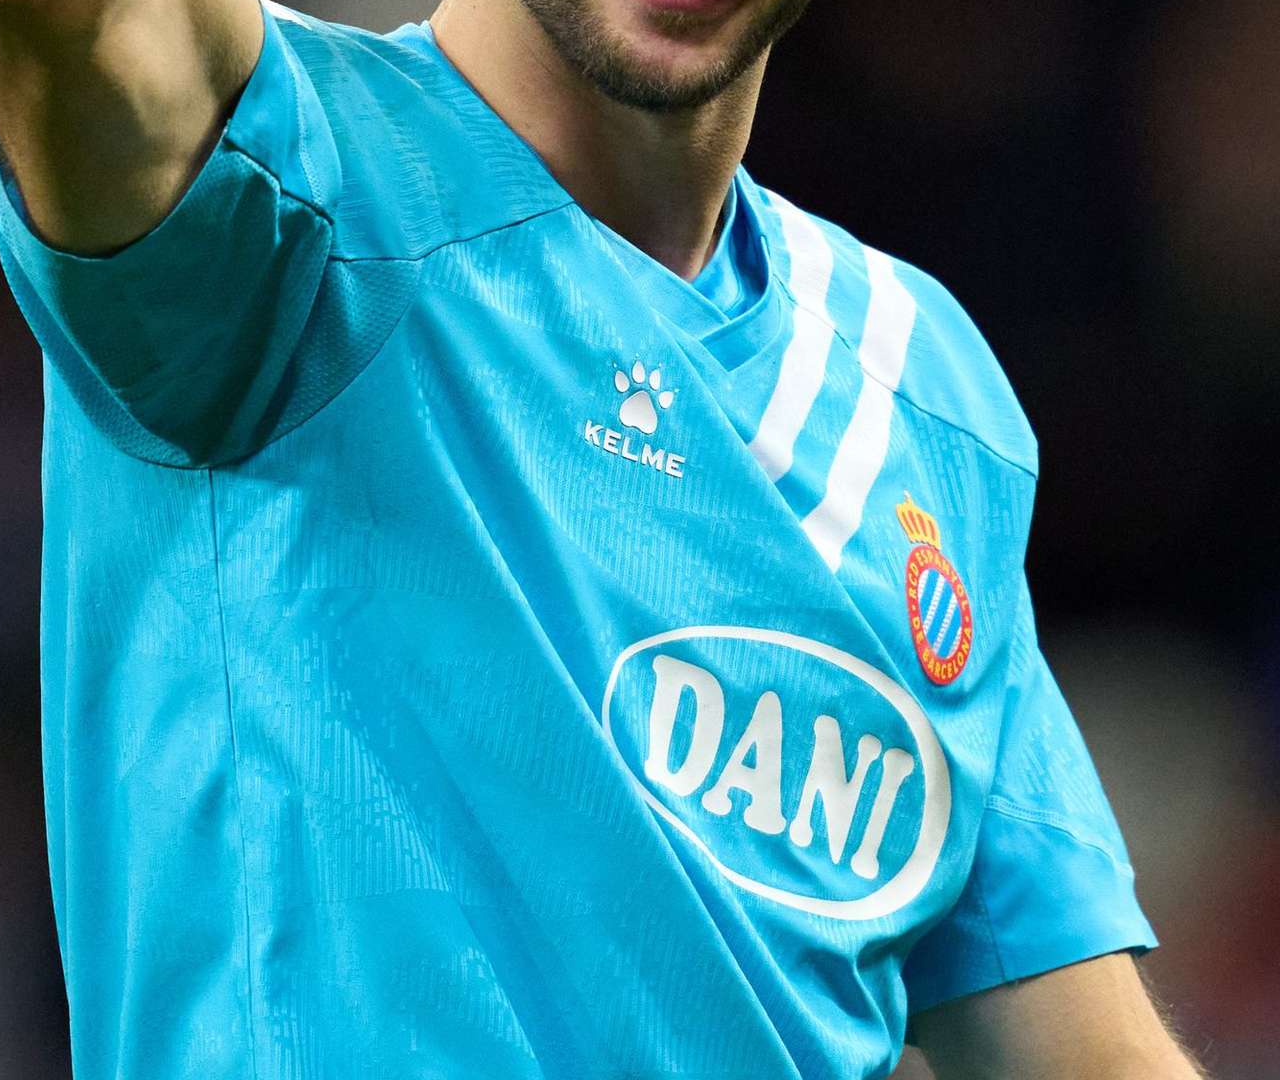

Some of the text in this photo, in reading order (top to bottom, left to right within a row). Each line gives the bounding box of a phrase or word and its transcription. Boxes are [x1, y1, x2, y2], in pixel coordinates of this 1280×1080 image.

[584, 419, 686, 478] KELME
[908, 562, 920, 600] RCD
[911, 616, 972, 680] DE BARCELONA
[644, 654, 915, 880] DANI
